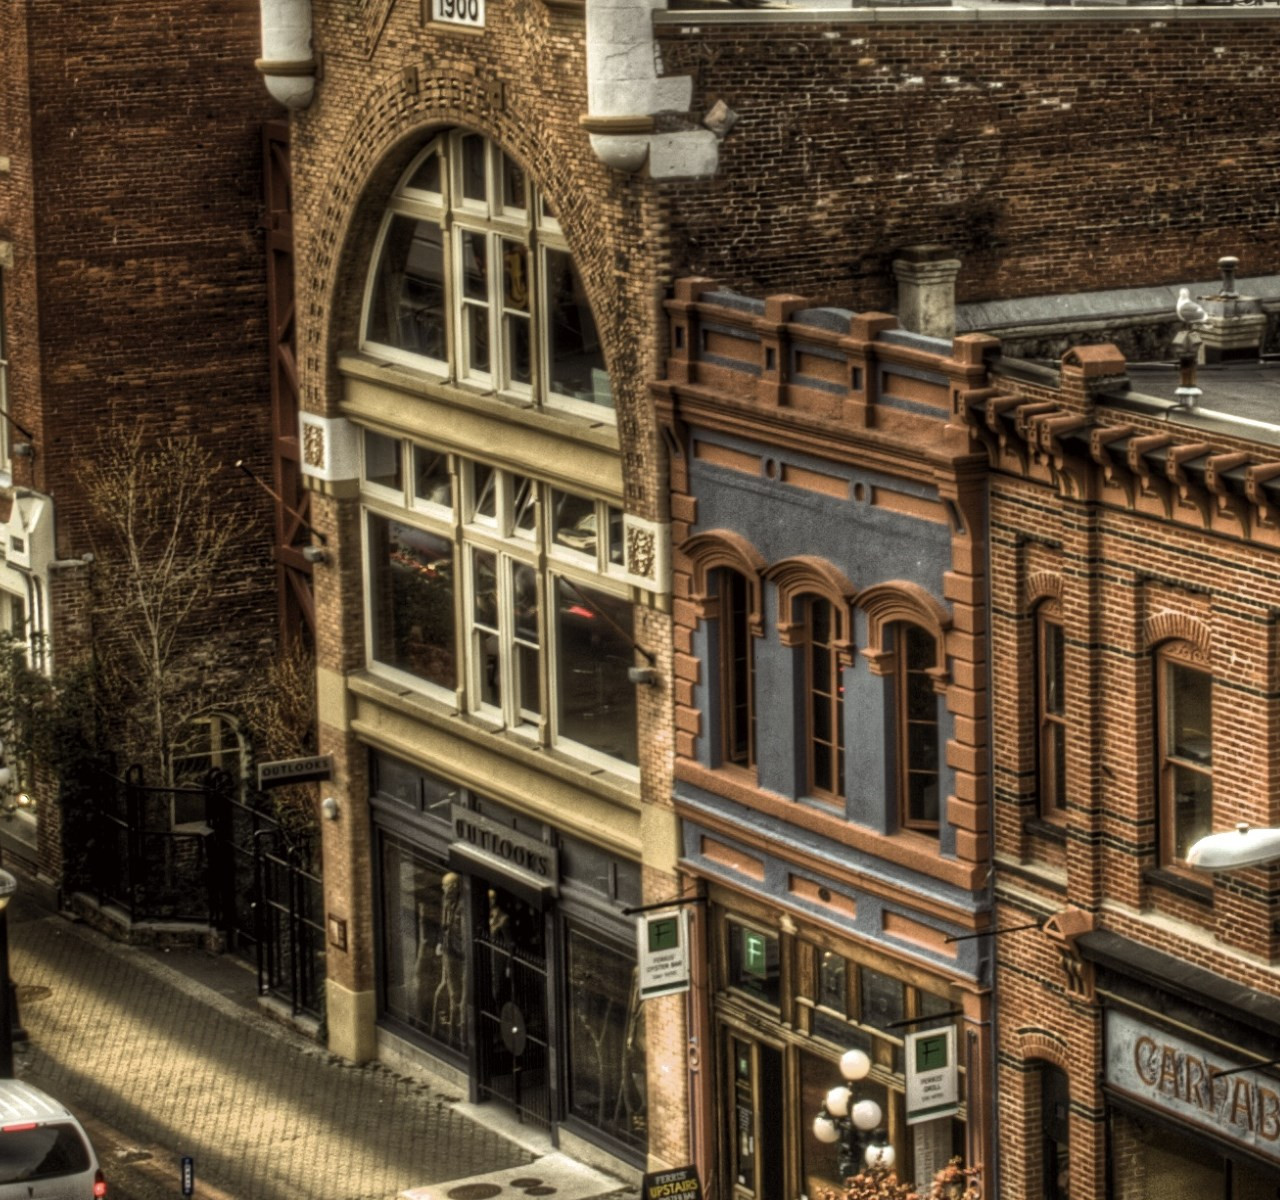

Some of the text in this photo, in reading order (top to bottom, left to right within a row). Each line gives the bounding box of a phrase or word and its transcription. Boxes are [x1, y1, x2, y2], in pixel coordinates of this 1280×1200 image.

[262, 760, 329, 777] OUTLOOKS
[456, 819, 548, 876] OUTLOOKS
[748, 937, 762, 966] F
[650, 1178, 698, 1198] UPSTAIRS
